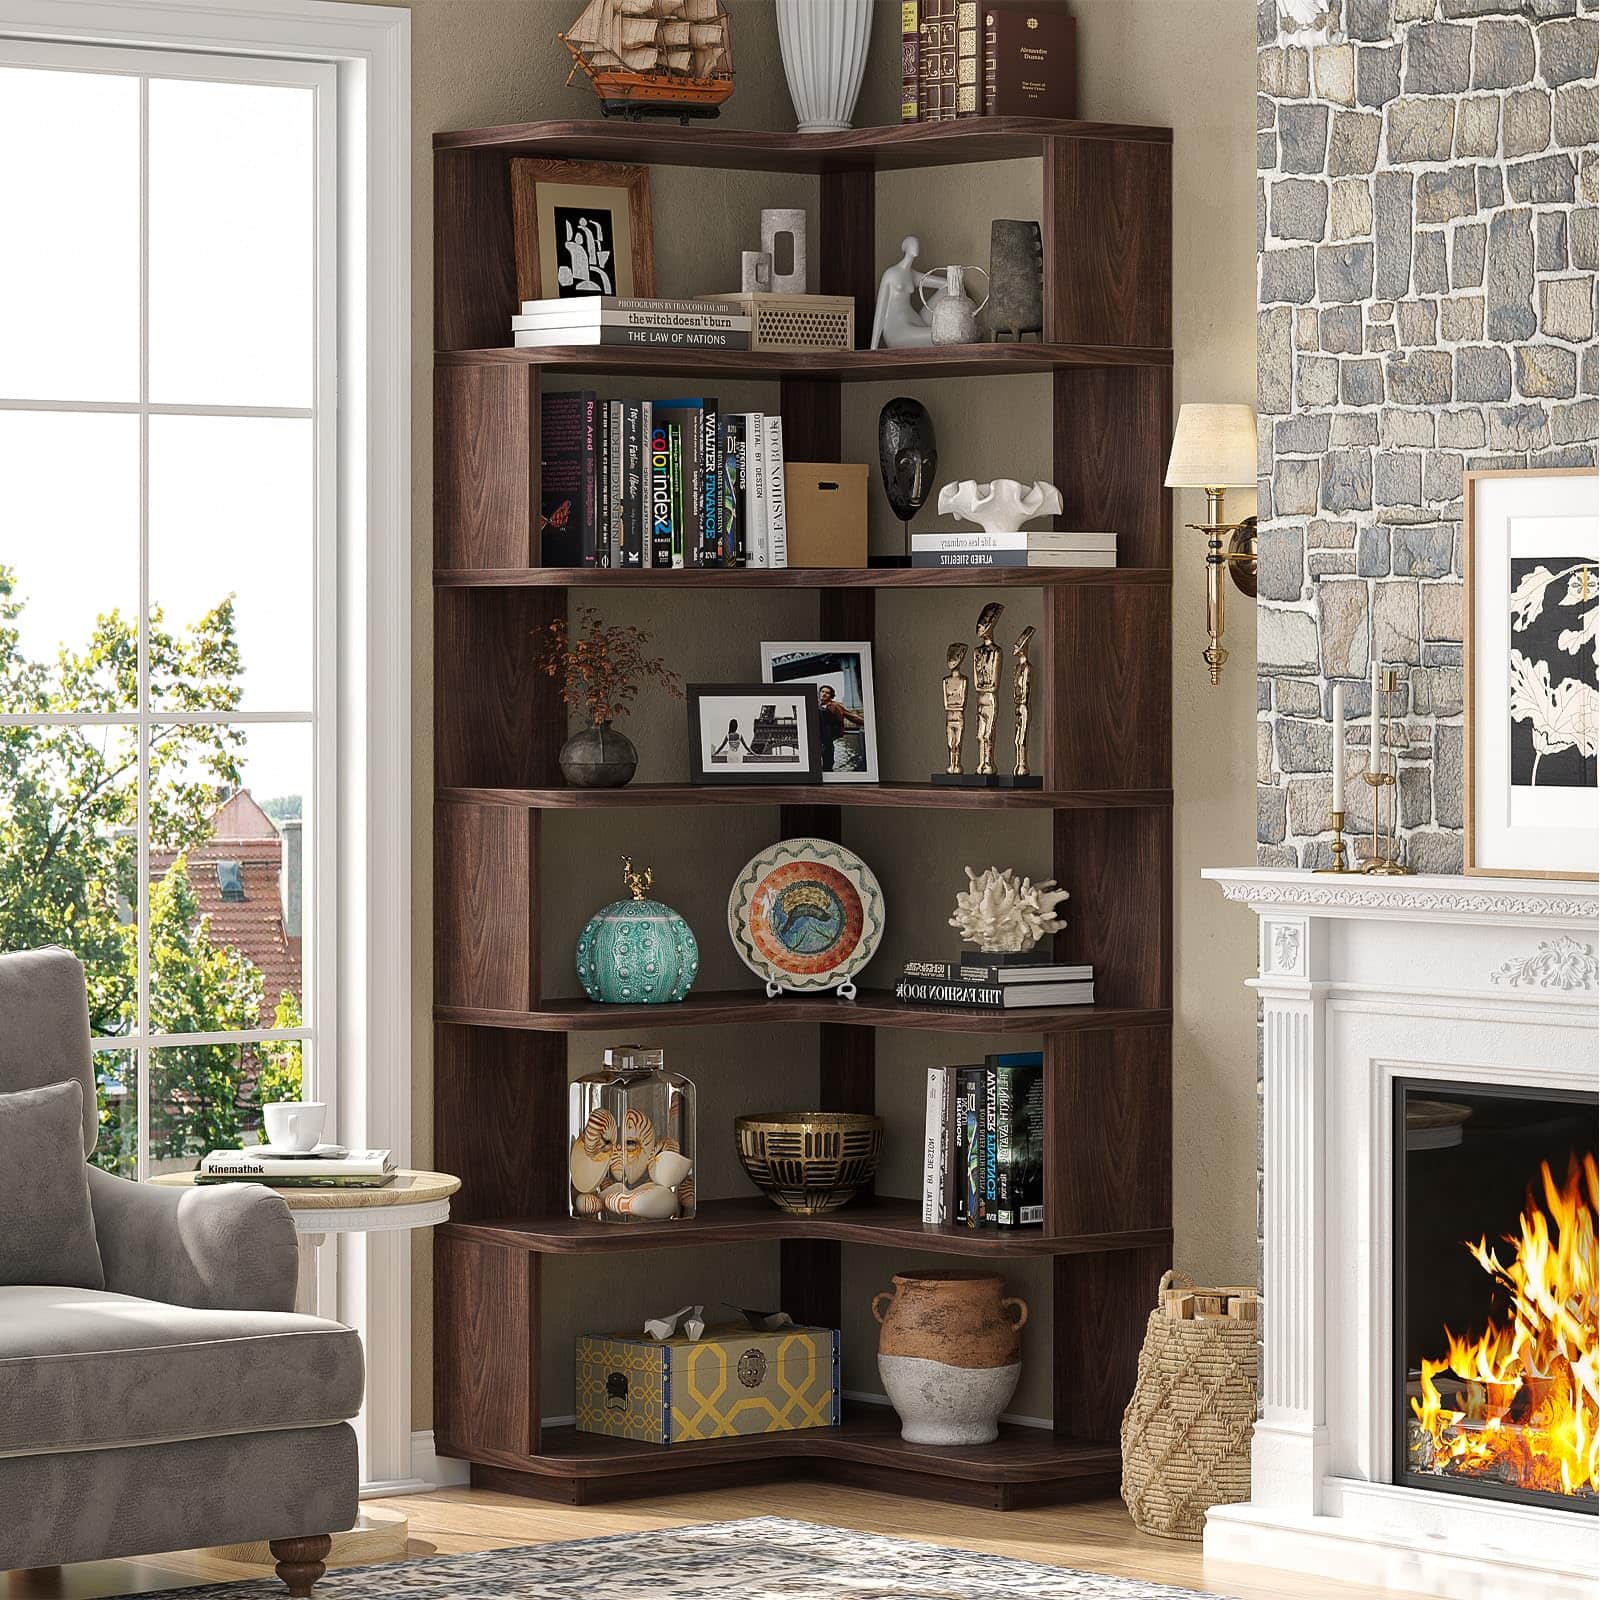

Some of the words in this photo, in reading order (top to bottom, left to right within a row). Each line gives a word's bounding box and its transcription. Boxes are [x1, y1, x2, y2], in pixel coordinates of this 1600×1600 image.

[618, 300, 664, 309] PHOTOGRAPHS
[628, 331, 646, 342] THE
[650, 333, 669, 343] LAW
[671, 333, 684, 344] OF
[687, 334, 726, 345] NATIONS
[705, 412, 716, 472] WALTER
[753, 414, 761, 447] DIGITAL
[755, 453, 762, 462] BY
[611, 411, 620, 543] INNENARCHITEKTUR
[706, 474, 716, 539] FINANCE
[774, 534, 785, 566] THE
[208, 1165, 265, 1174] Kinemathek
